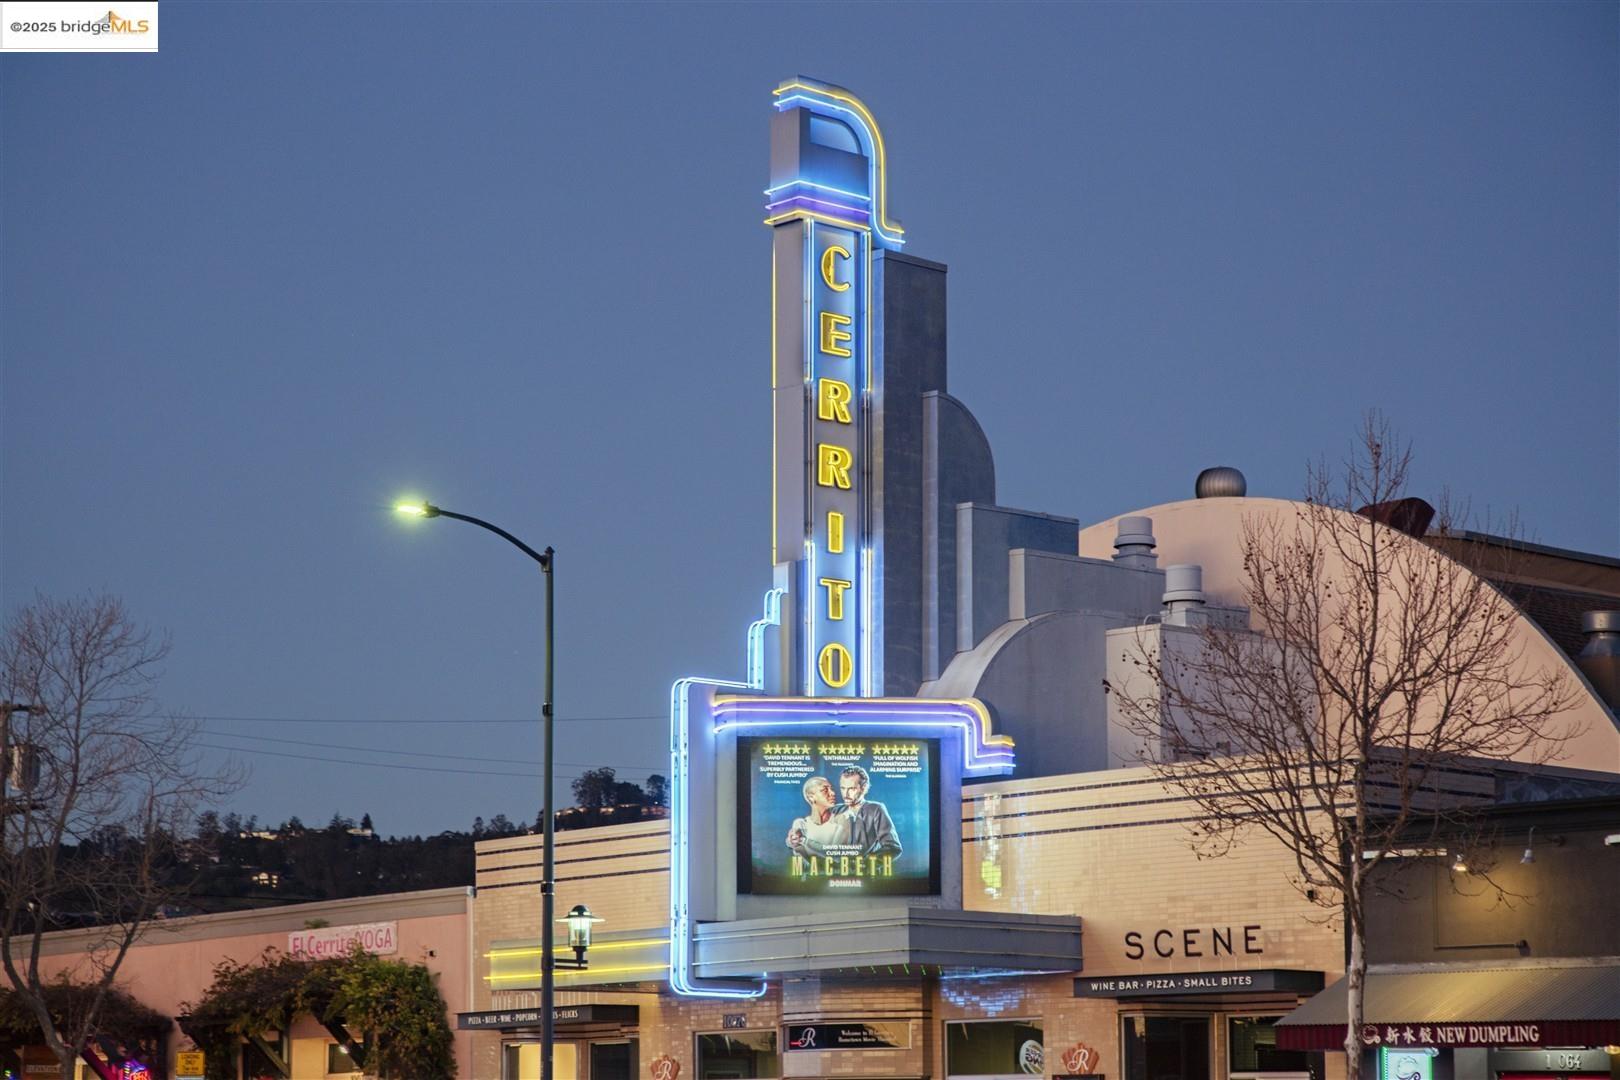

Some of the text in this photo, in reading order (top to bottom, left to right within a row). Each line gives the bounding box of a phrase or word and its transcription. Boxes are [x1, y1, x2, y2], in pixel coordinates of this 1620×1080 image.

[817, 246, 853, 688] CERRITO
[792, 856, 892, 876] MACBETH
[293, 937, 304, 956] El
[1125, 925, 1263, 960] SCENE
[1091, 976, 1252, 991] WINE BAR PIZZA SMALL BITES
[468, 1016, 482, 1025] PIZZA
[1437, 1025, 1539, 1043] NEW DUMPLING
